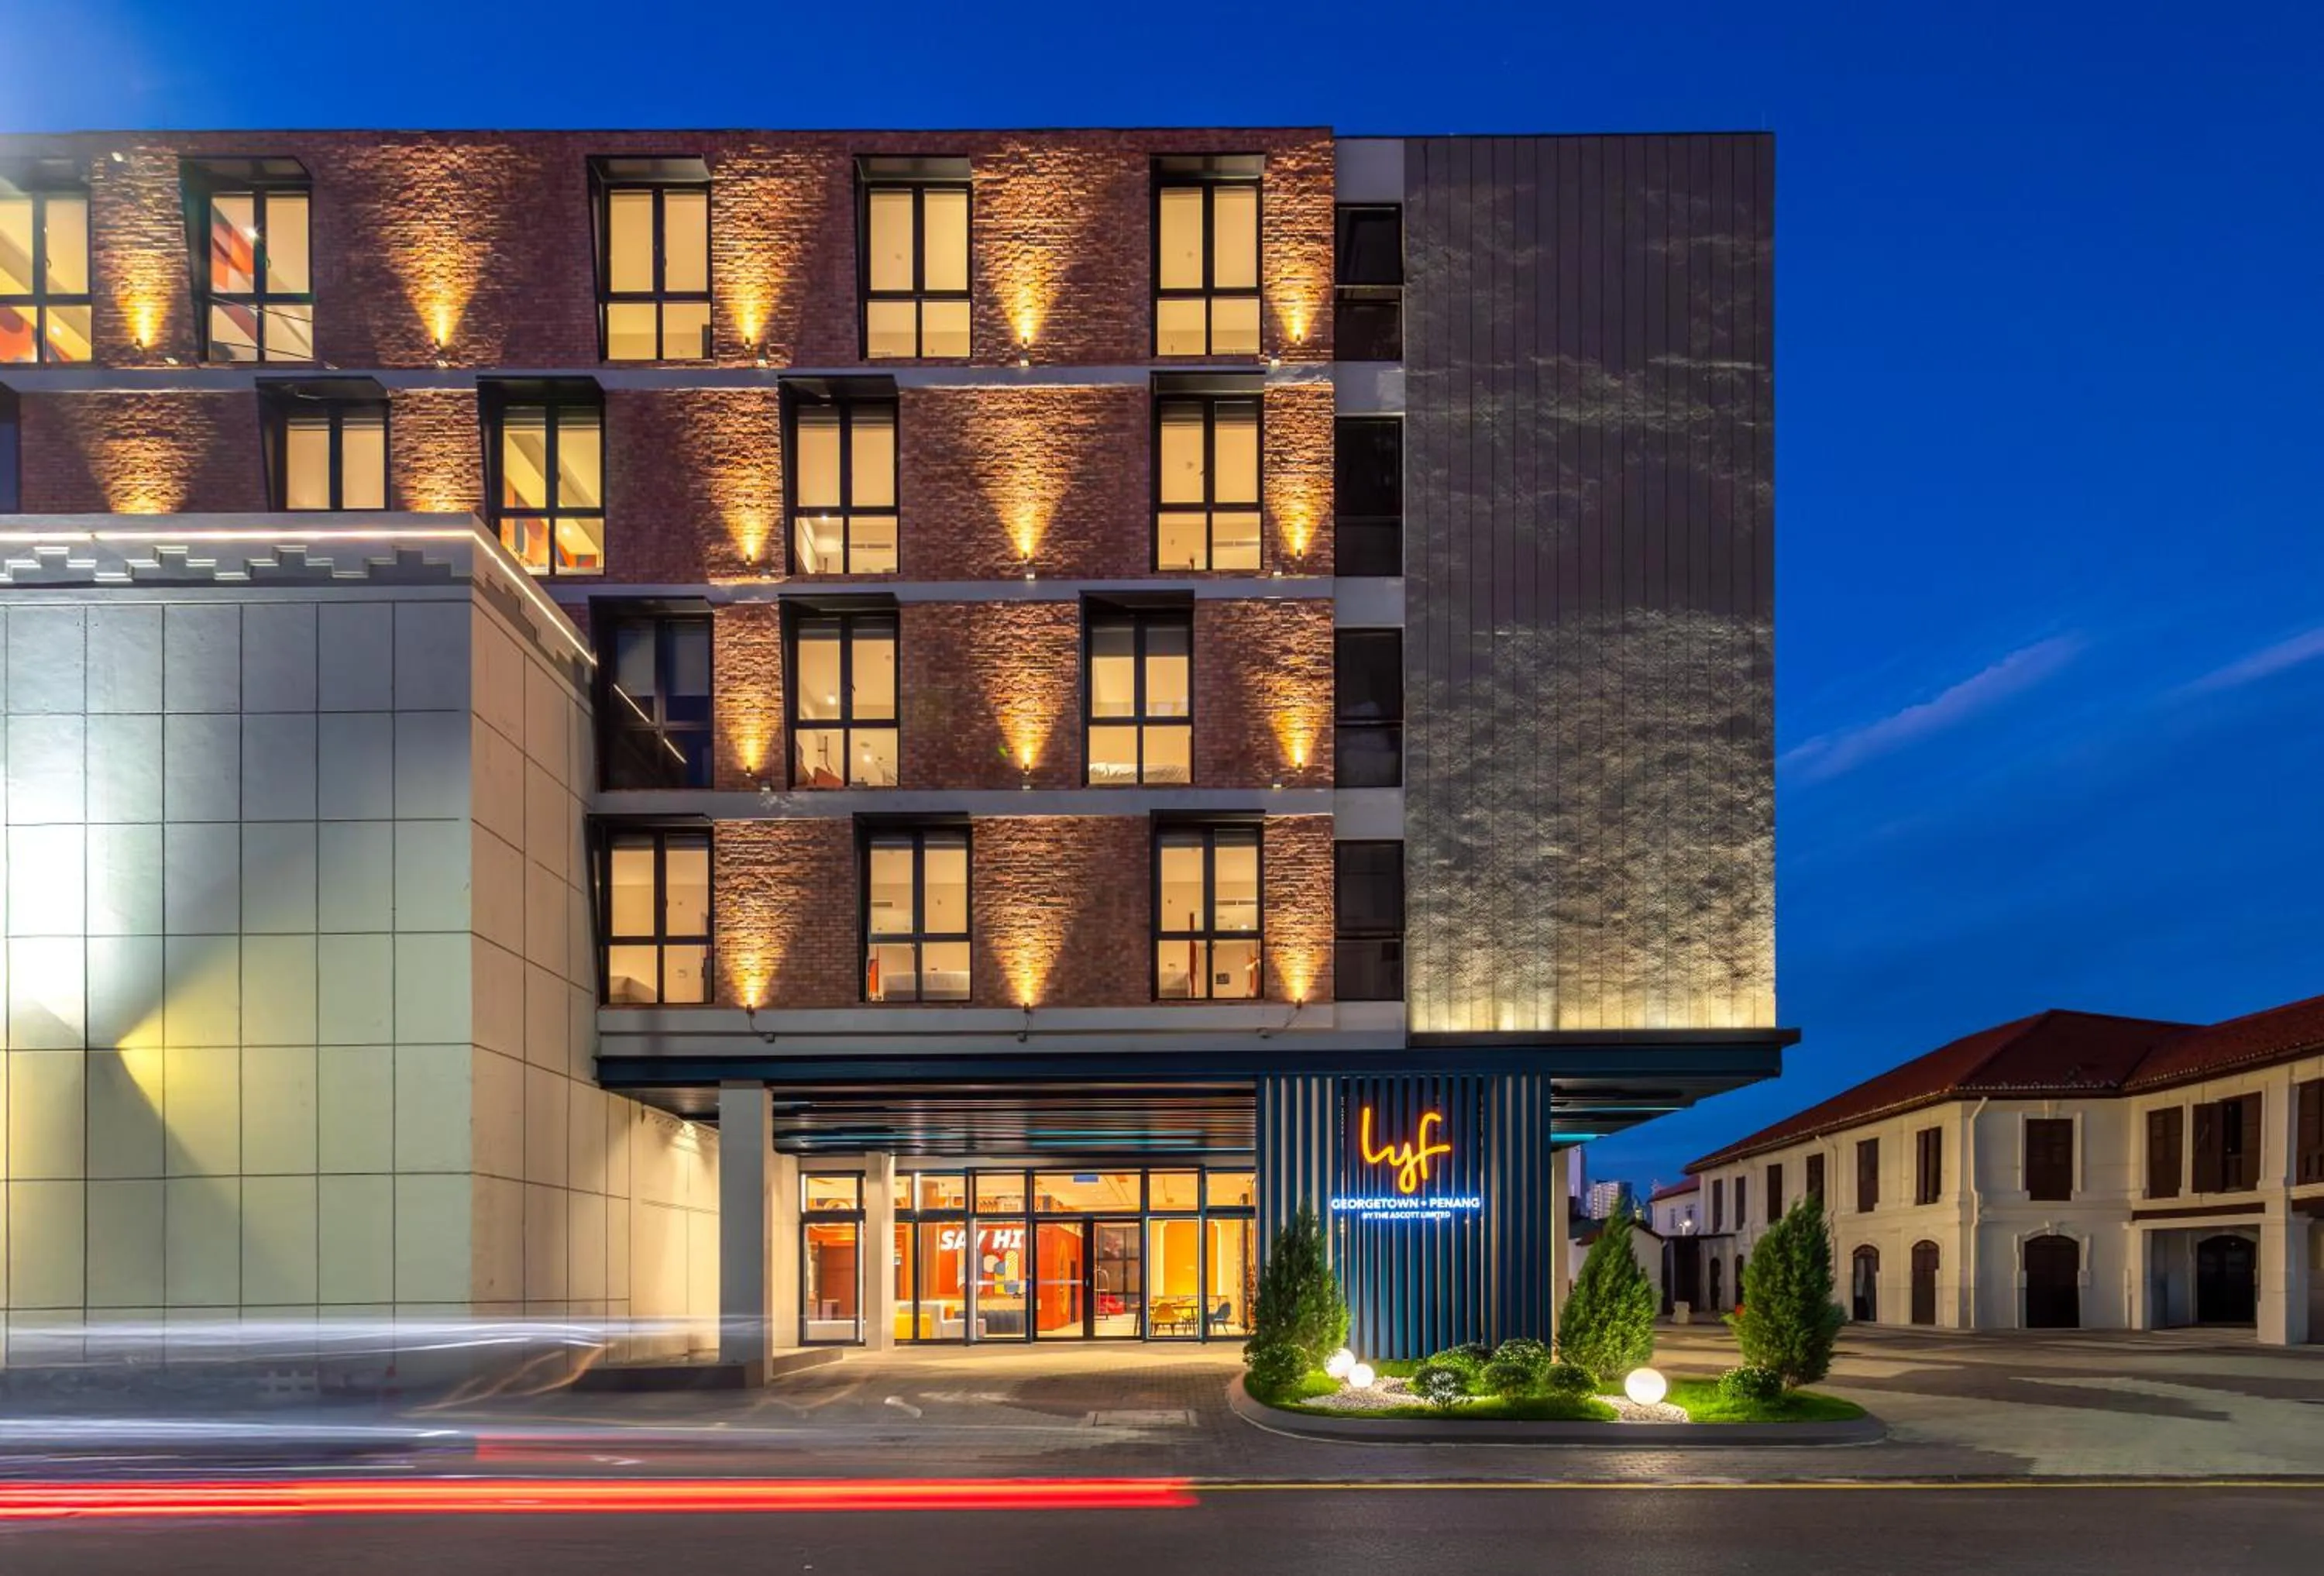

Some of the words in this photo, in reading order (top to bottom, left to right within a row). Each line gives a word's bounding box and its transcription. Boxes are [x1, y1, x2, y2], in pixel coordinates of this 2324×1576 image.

[1361, 1106, 1451, 1193] lyf
[1331, 1198, 1418, 1210] GEORGETOWN
[1429, 1197, 1480, 1209] PENANG
[1375, 1211, 1389, 1220] THE
[992, 1229, 1024, 1250] HI
